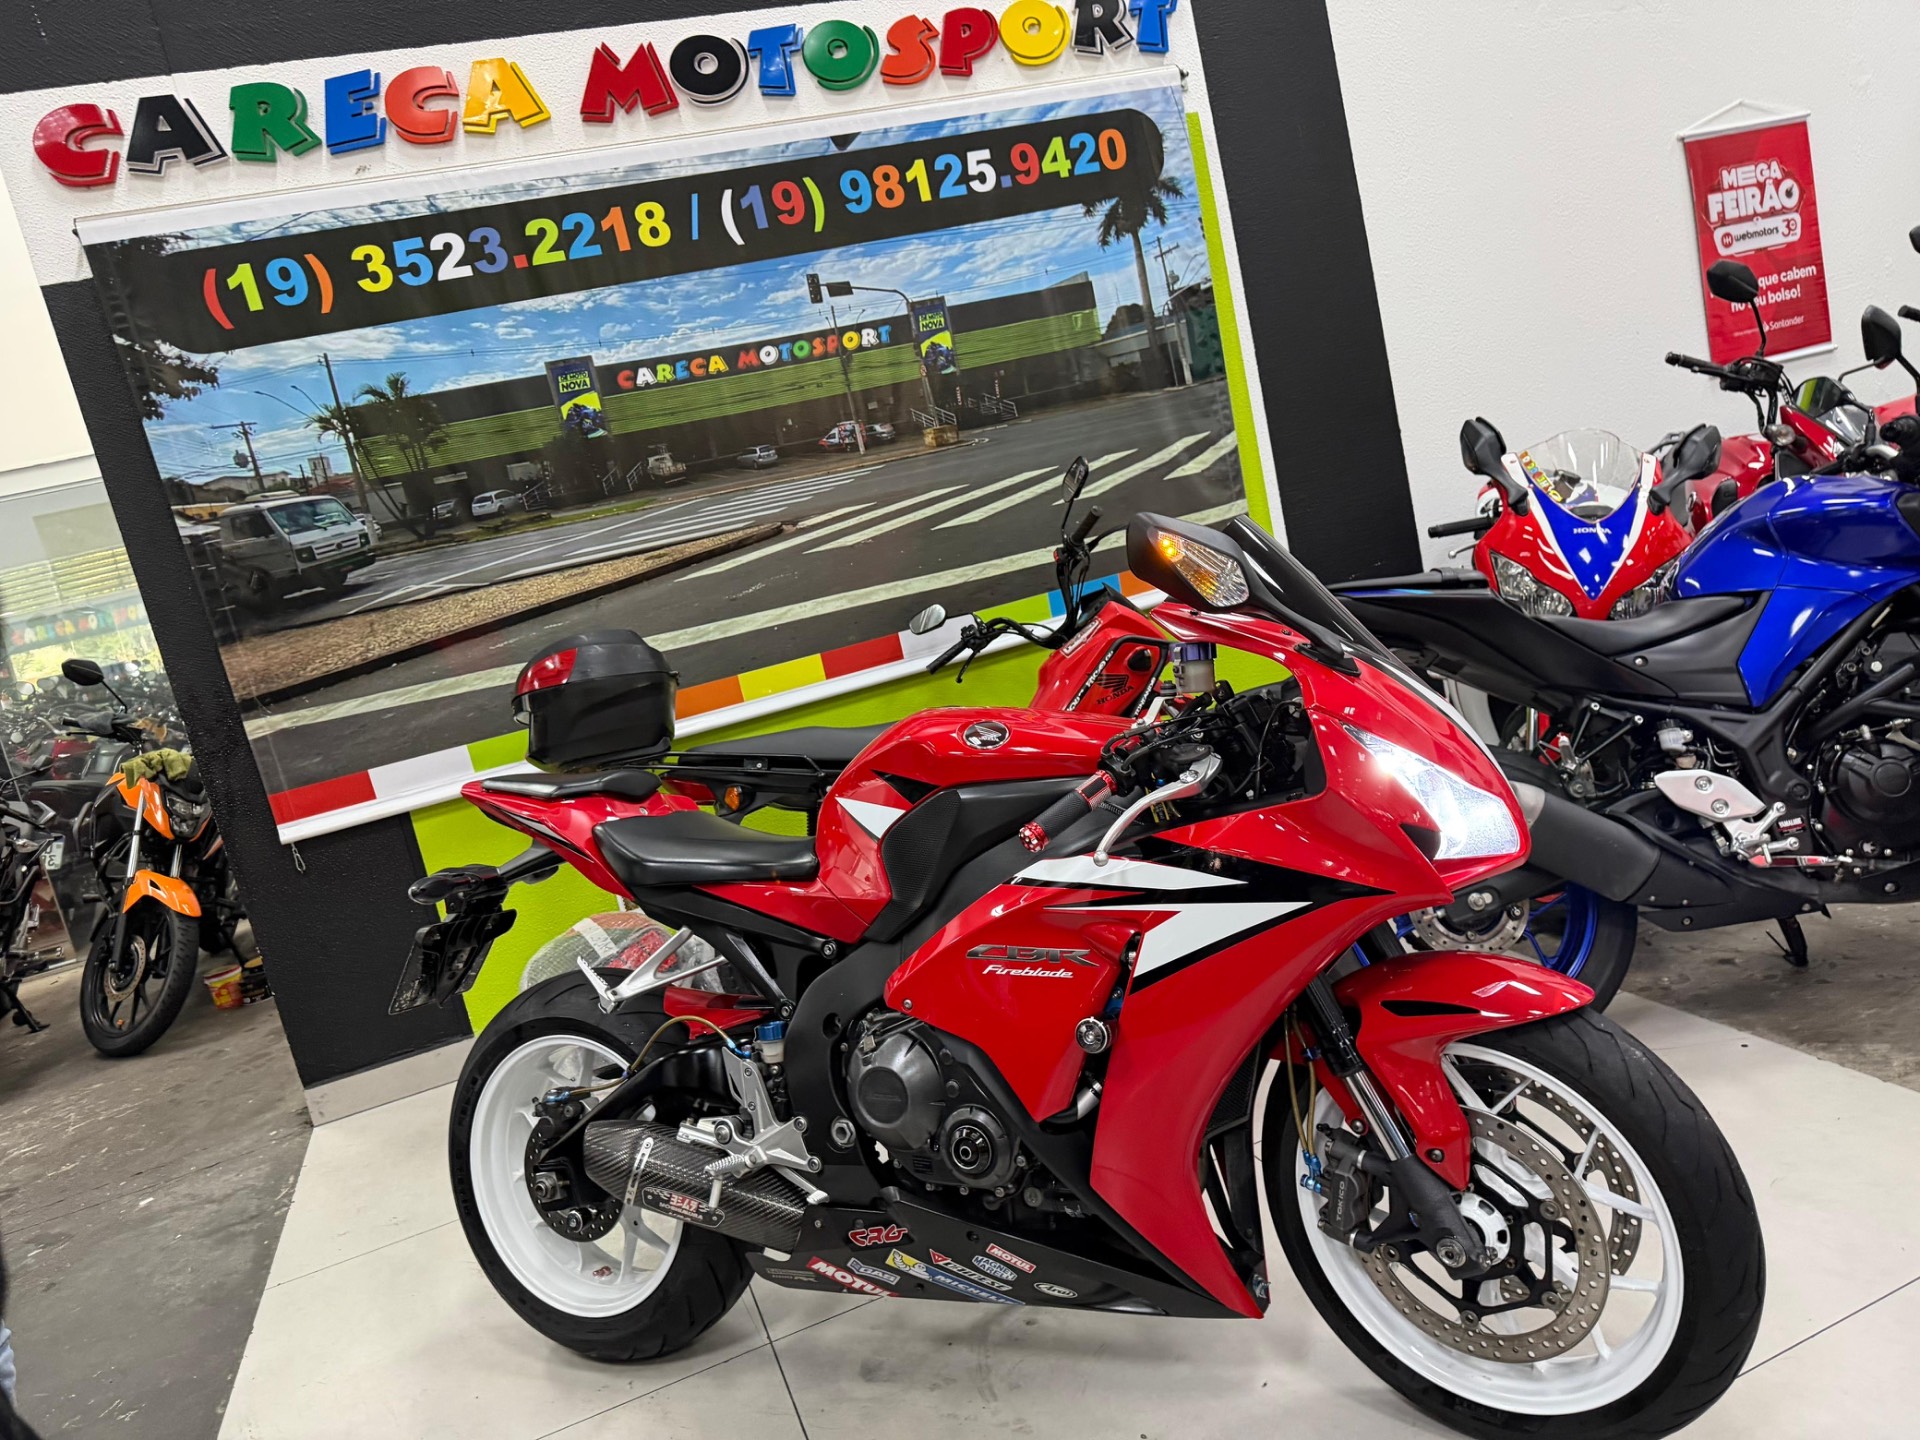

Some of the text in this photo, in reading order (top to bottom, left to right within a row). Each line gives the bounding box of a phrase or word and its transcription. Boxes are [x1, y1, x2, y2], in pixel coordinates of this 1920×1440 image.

[33, 0, 1178, 188] CARECA MOTOSPORT
[1721, 160, 1782, 190] MEGA
[1707, 178, 1800, 223] FEIRÃO
[203, 254, 334, 330] (19)
[350, 201, 672, 294] 3523.2218
[721, 177, 825, 246] (19)
[840, 128, 1128, 214] 98125.9420
[1735, 227, 1779, 242] webmotors
[1757, 264, 1817, 290] que cabem
[1767, 283, 1801, 306] bolso!
[921, 320, 943, 330] NOVA
[1769, 315, 1805, 331] Santander
[616, 324, 891, 390] CARECA MOTOSPORT
[561, 380, 589, 392] NOVA
[1096, 686, 1134, 705] HONDA
[966, 943, 1100, 967] CBR
[982, 964, 1073, 979] Fireblade
[1335, 1181, 1345, 1222] TOKICO
[990, 1247, 1031, 1271] MOTUL
